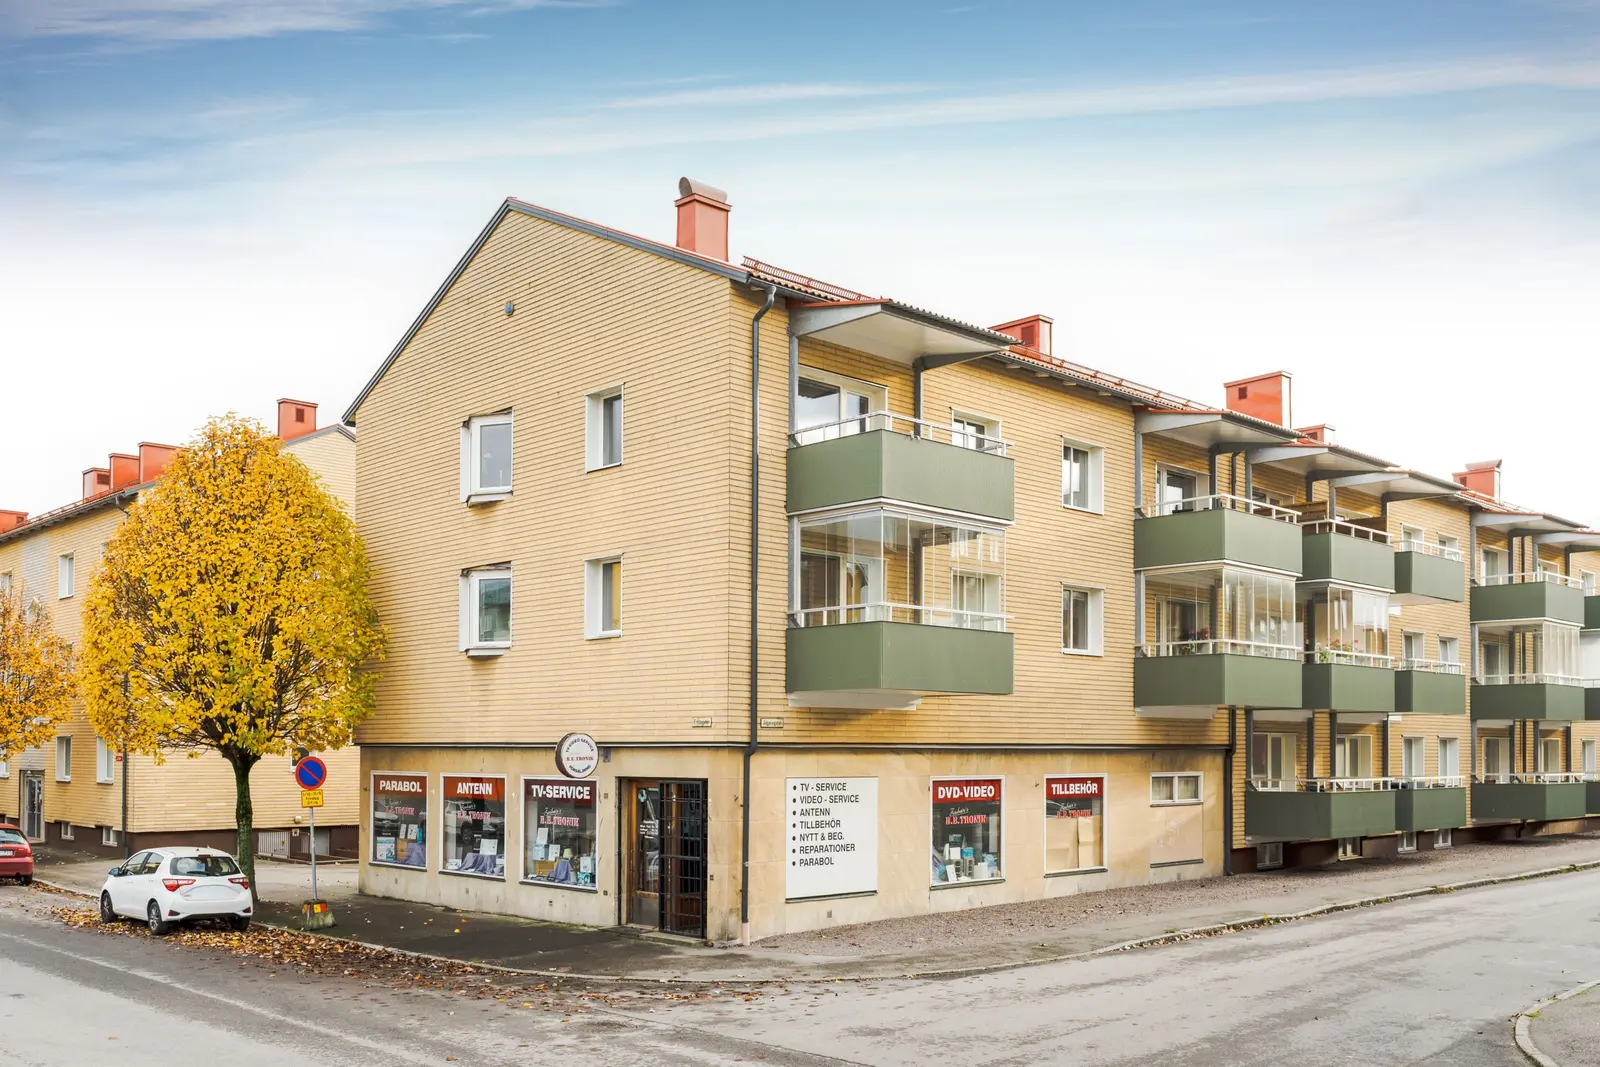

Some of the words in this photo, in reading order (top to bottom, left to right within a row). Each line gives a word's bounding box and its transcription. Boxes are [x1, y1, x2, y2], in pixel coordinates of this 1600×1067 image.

[379, 780, 422, 792] PARABOL
[456, 782, 492, 795] ANTENN
[800, 783, 809, 791] TV
[815, 782, 847, 791] SERVICE
[937, 785, 995, 798] DVD-VIDEO
[1051, 780, 1098, 794] TILLBEHÖR
[531, 785, 591, 799] TV-SERVICE
[800, 795, 823, 804] VIDEO
[829, 794, 860, 803] SERVICE
[800, 808, 831, 817] ANTENN
[800, 817, 841, 829] TILLBEHÖR
[800, 833, 819, 842] NYTT
[820, 833, 826, 841] &
[828, 832, 845, 840] BEG.
[800, 843, 856, 854] REPARATIONER
[800, 857, 835, 867] PARABOL
